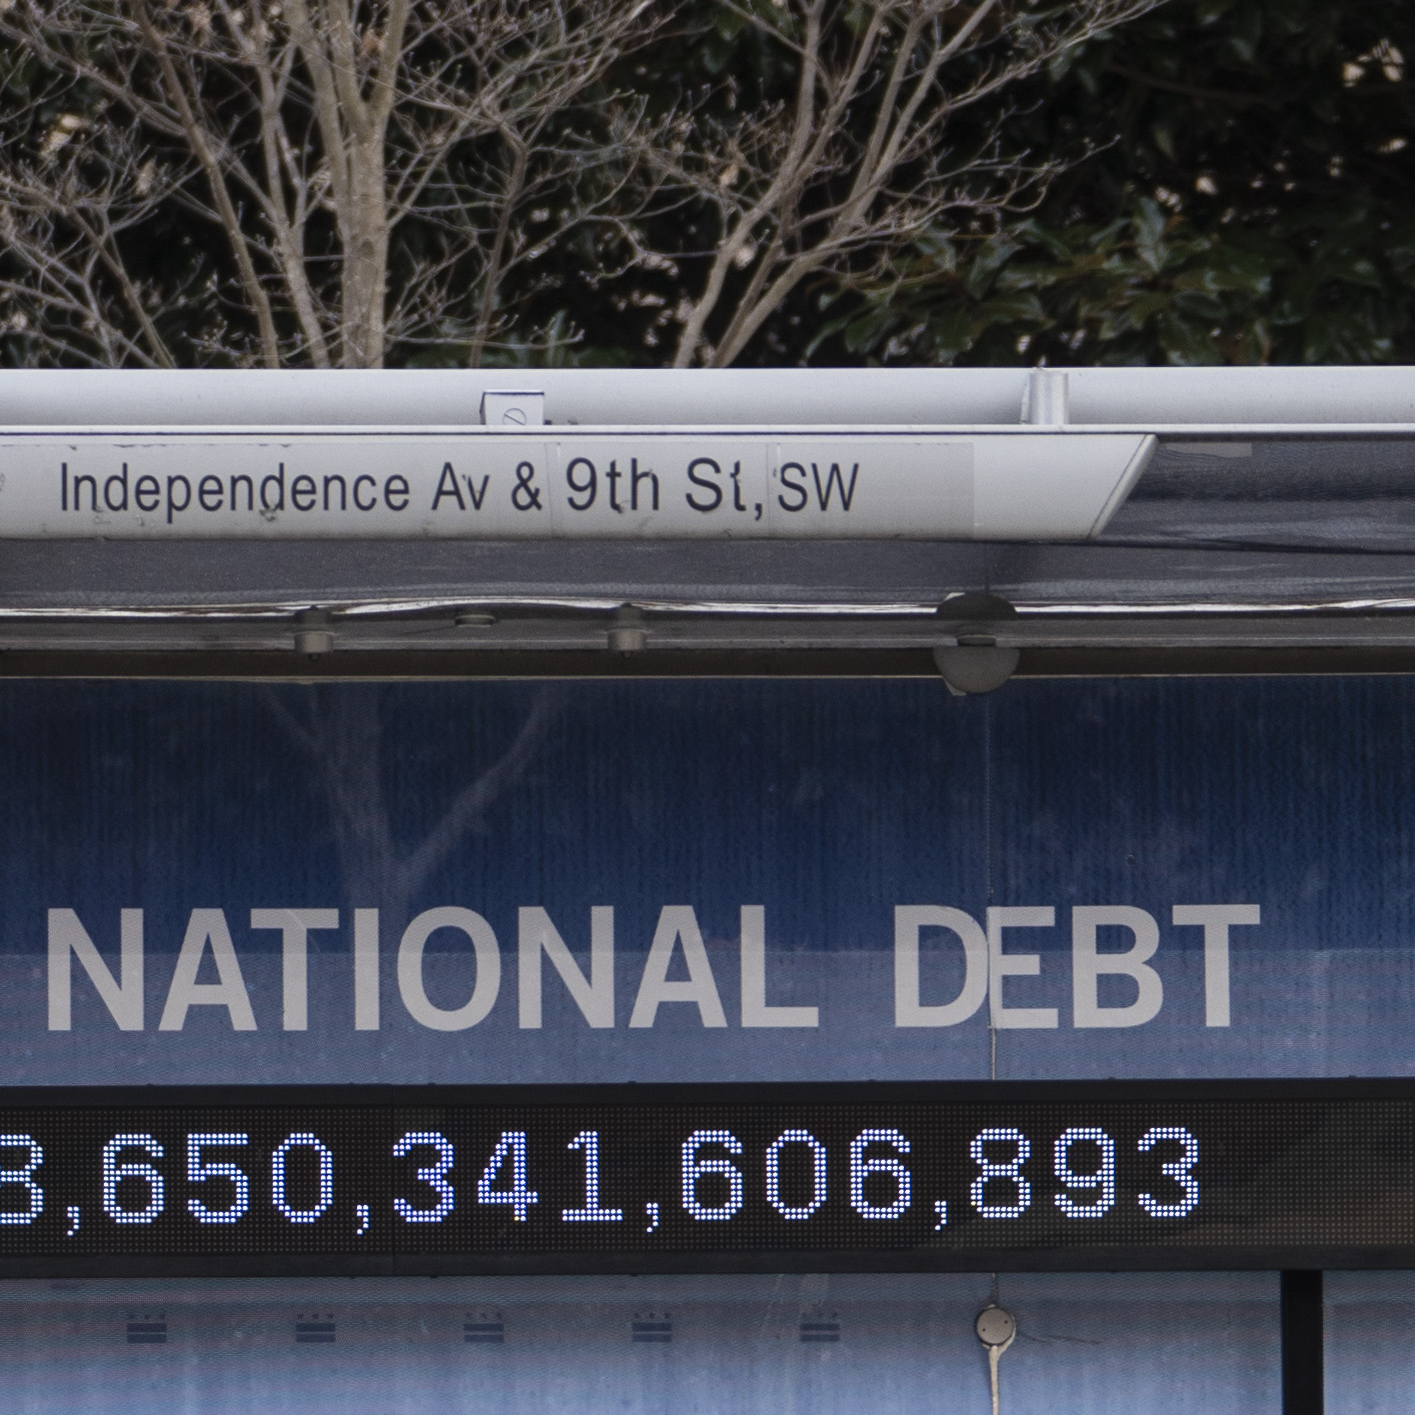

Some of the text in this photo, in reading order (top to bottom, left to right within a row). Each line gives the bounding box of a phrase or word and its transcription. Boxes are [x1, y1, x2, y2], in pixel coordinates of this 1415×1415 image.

[60, 462, 410, 524] Independence
[431, 461, 490, 511] Av
[511, 460, 543, 511] &
[565, 456, 659, 513] 9th
[47, 905, 820, 1034] NATIONAL
[894, 903, 1261, 1030] DEBT
